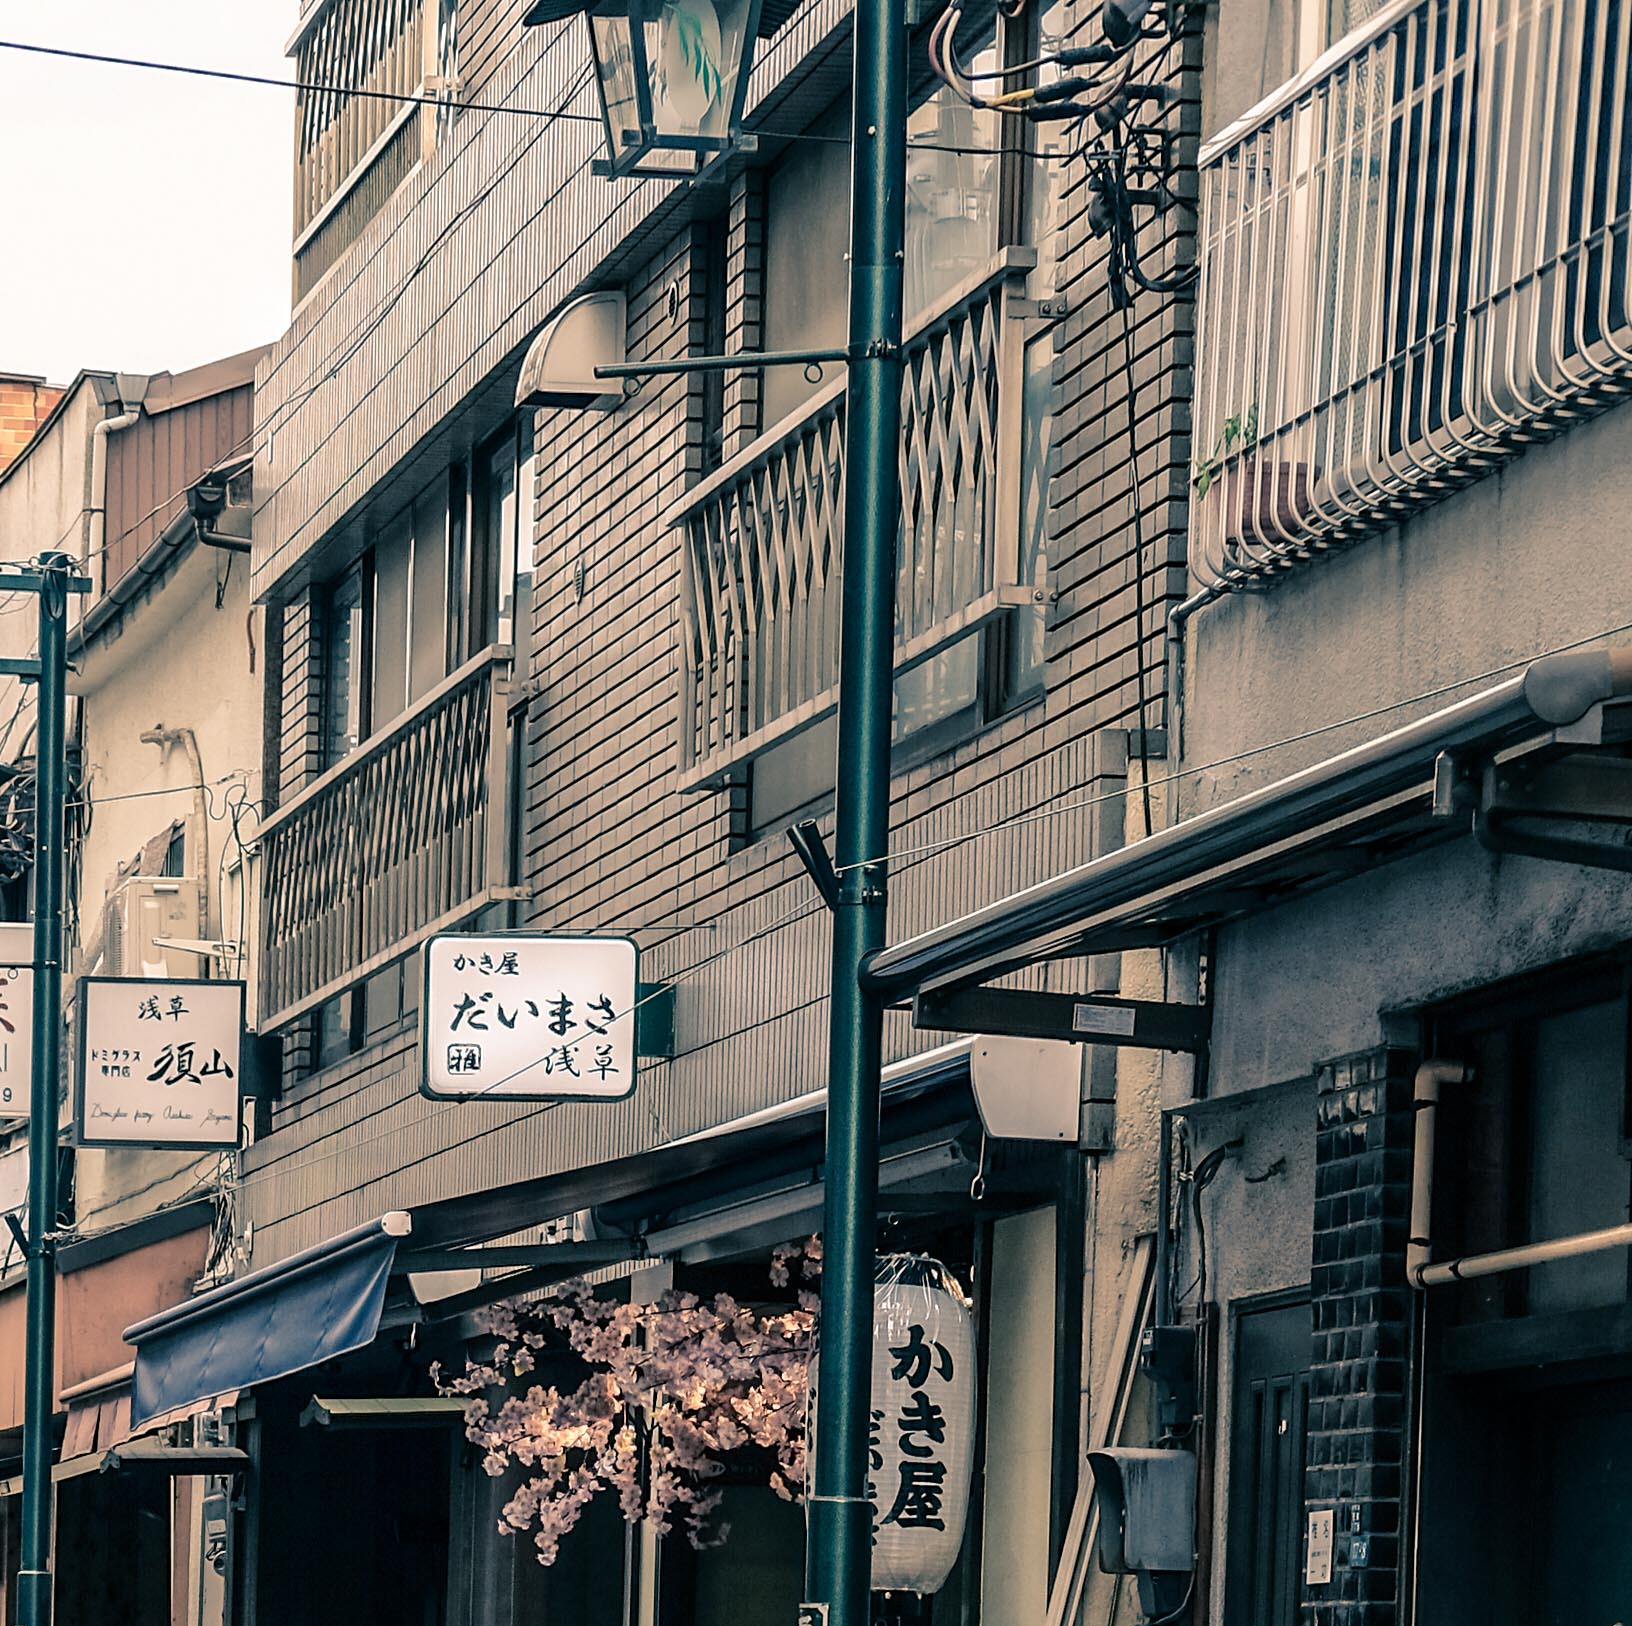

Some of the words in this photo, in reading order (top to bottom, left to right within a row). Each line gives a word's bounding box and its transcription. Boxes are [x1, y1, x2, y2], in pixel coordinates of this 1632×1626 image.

[453, 952, 520, 975] かき屋
[138, 995, 190, 1021] 浅草
[449, 991, 616, 1036] だいまさ
[146, 1041, 234, 1086] 須山
[544, 1043, 621, 1082] 浅草
[880, 1323, 954, 1532] かき屋
